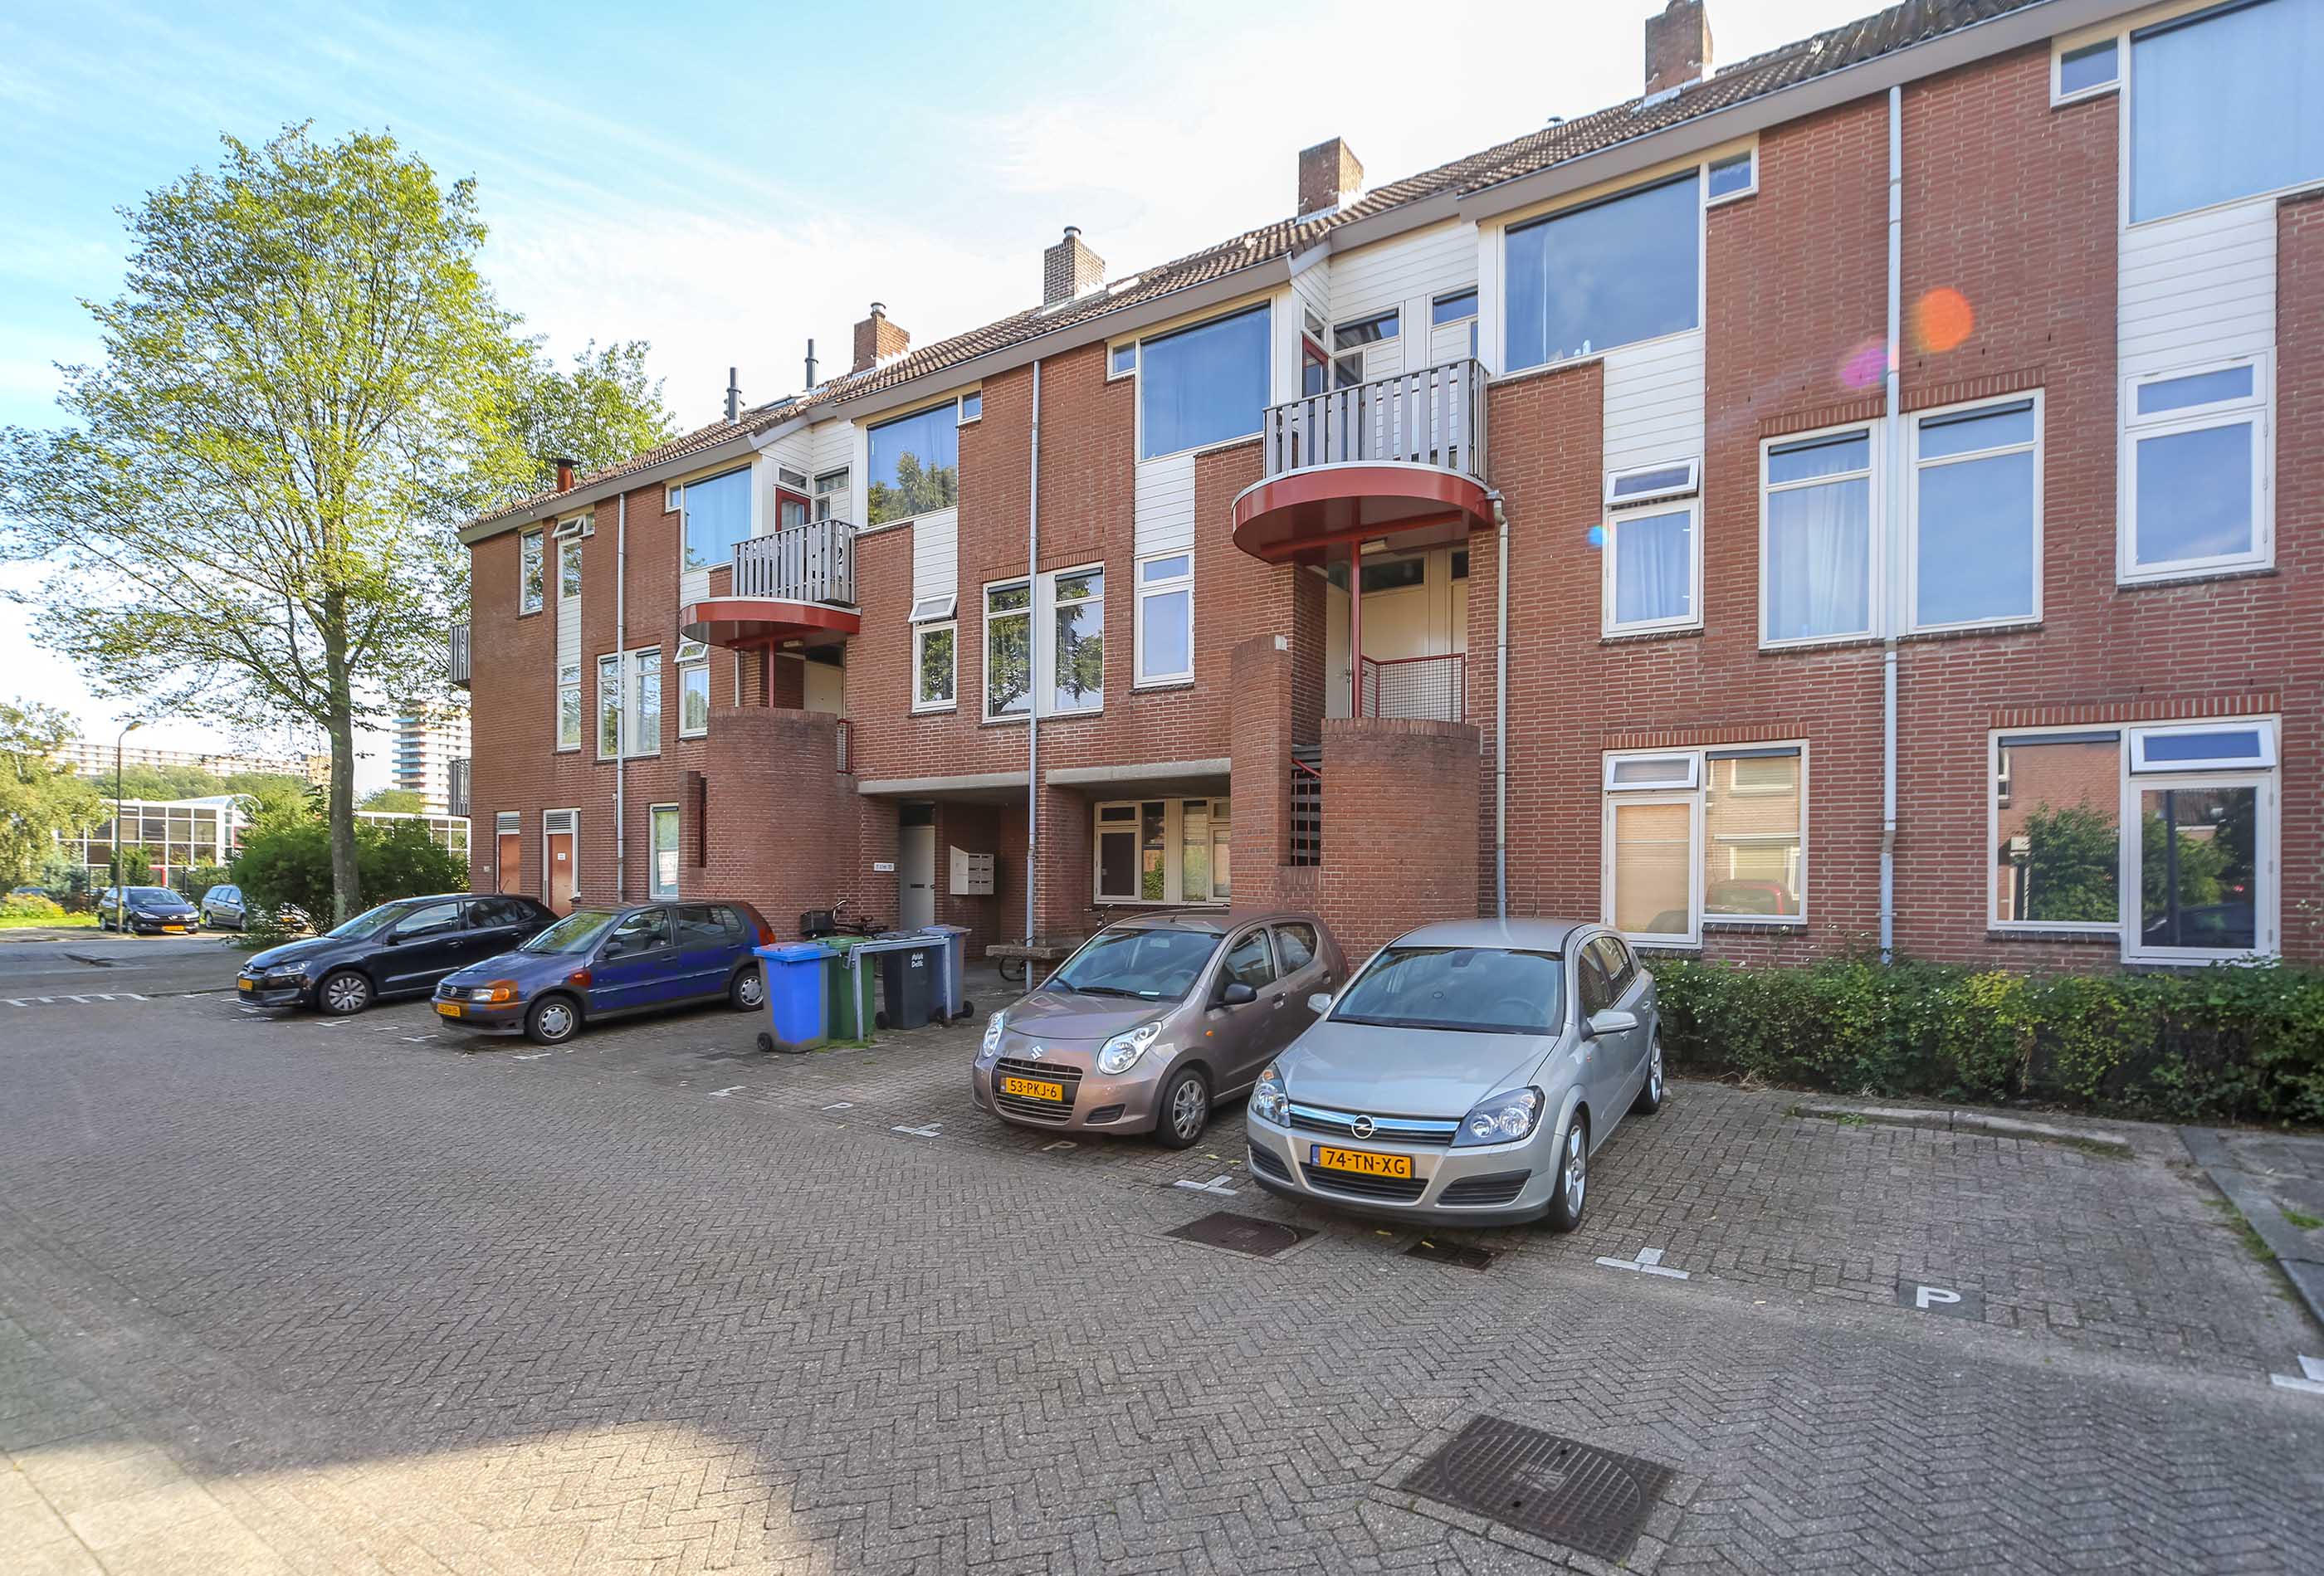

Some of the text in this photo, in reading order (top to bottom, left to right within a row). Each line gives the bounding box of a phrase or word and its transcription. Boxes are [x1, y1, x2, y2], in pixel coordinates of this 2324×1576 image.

[1010, 1081, 1057, 1097] 53-PKJ-6
[1326, 1150, 1404, 1174] 74-TN-XG
[1916, 1286, 1961, 1308] P
